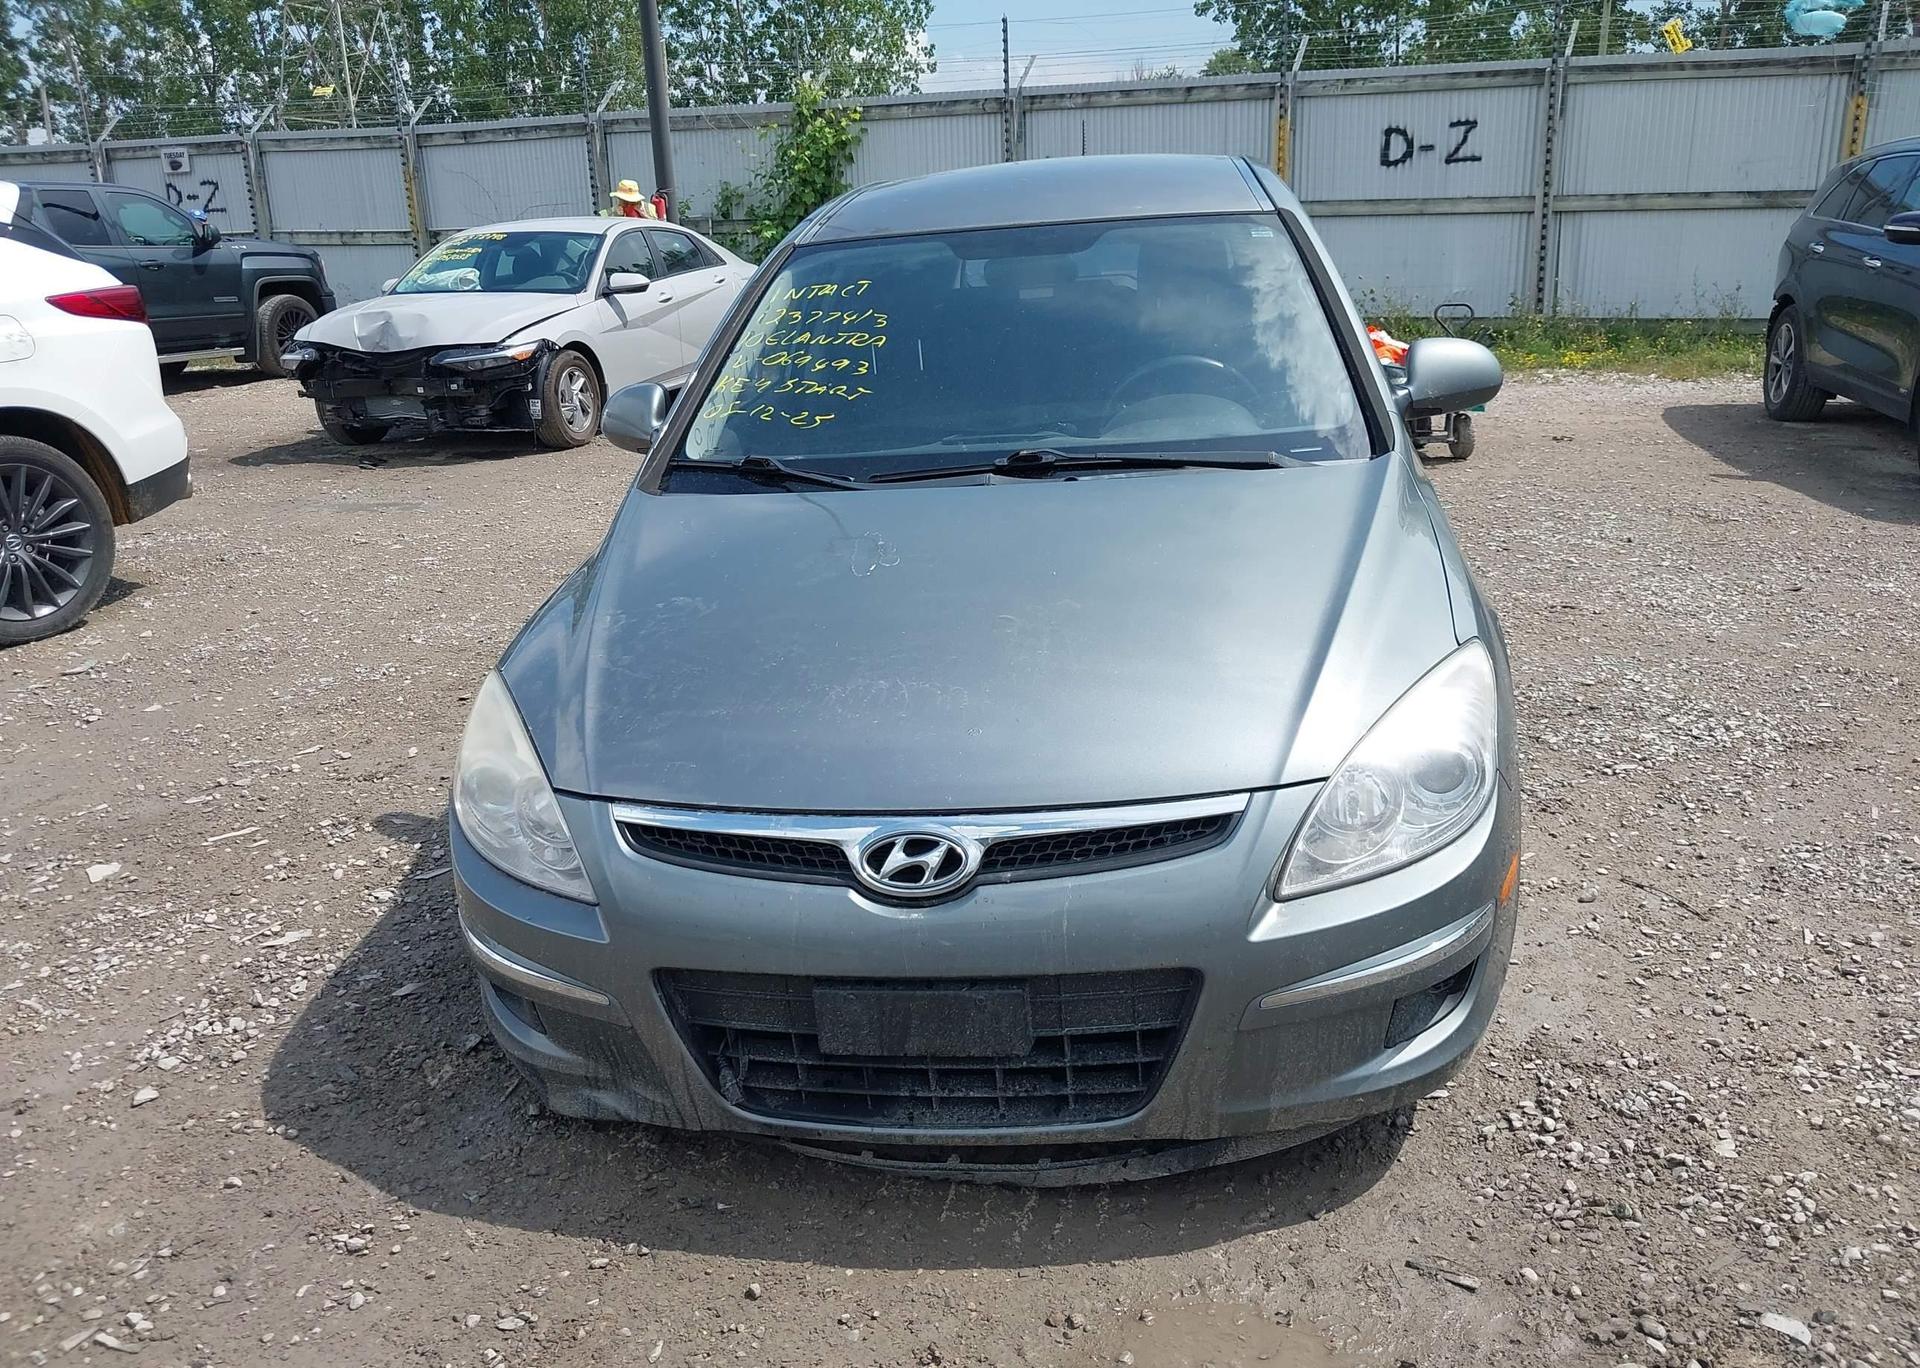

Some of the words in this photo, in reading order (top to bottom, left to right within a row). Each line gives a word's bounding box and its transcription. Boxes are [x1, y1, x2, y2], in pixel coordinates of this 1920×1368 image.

[163, 151, 185, 160] TUESDAY
[1380, 119, 1482, 168] D-Z
[166, 180, 227, 213] D-Z
[770, 280, 873, 303] INTACT
